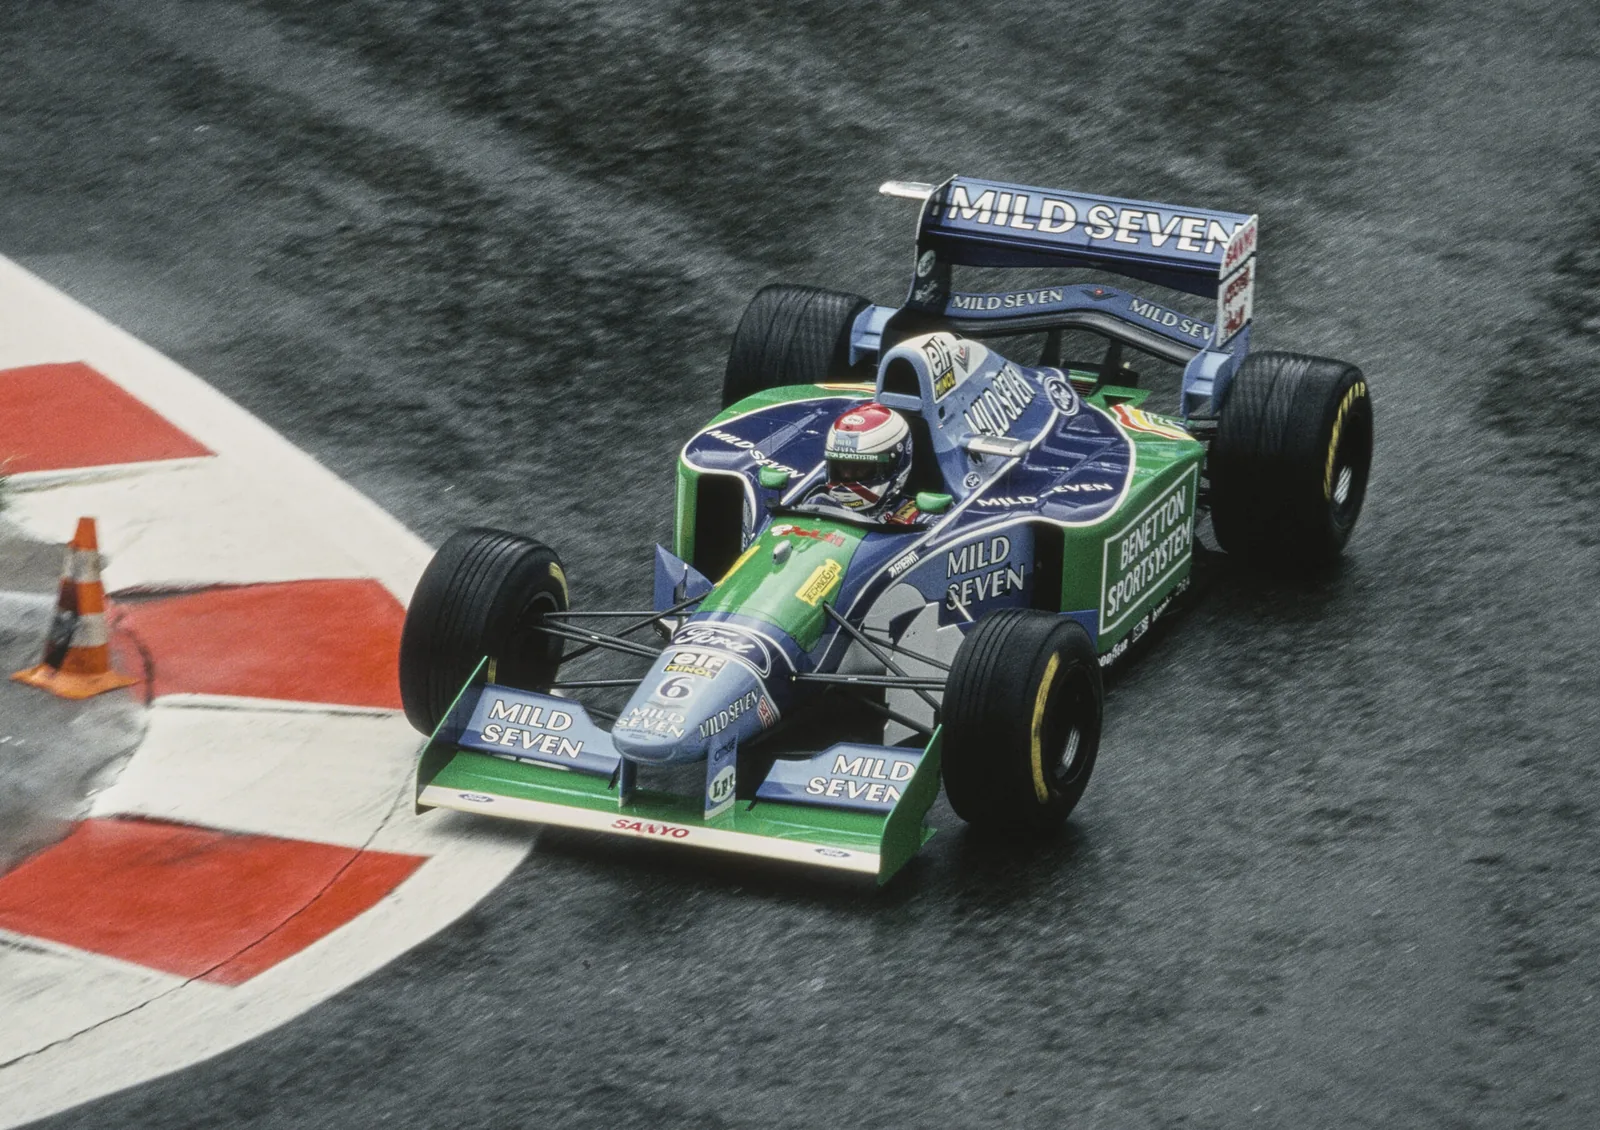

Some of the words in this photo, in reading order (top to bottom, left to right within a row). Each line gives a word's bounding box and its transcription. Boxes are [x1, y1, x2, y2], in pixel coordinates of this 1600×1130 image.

[948, 186, 1077, 233] MILD
[1085, 205, 1243, 254] SEVEN
[953, 294, 1001, 310] MILD
[1004, 288, 1064, 308] SEVEN
[1128, 299, 1178, 327] MILD
[1178, 314, 1214, 342] SEV
[927, 337, 951, 377] elf
[964, 387, 1010, 437] MILD
[992, 363, 1036, 421] SEVEN
[706, 430, 755, 448] MILD
[977, 495, 1038, 507] MILD
[1120, 485, 1186, 571] BENETTON
[946, 536, 1011, 578] MILD
[1107, 516, 1191, 617] SPORTSYSTEM
[946, 565, 1024, 610] SEVEN
[675, 628, 755, 653] Ford
[665, 665, 713, 678] MINOL
[672, 653, 725, 669] elf
[659, 676, 692, 699] 6
[488, 699, 574, 732] MILD
[615, 717, 685, 739] SEVEN
[629, 707, 686, 725] MILD
[699, 711, 729, 740] MILD
[728, 688, 758, 723] SEVEN
[480, 723, 584, 760] SEVEN
[831, 754, 917, 783] MILD
[805, 776, 903, 804] SEVEN
[611, 818, 690, 839] SANYO
